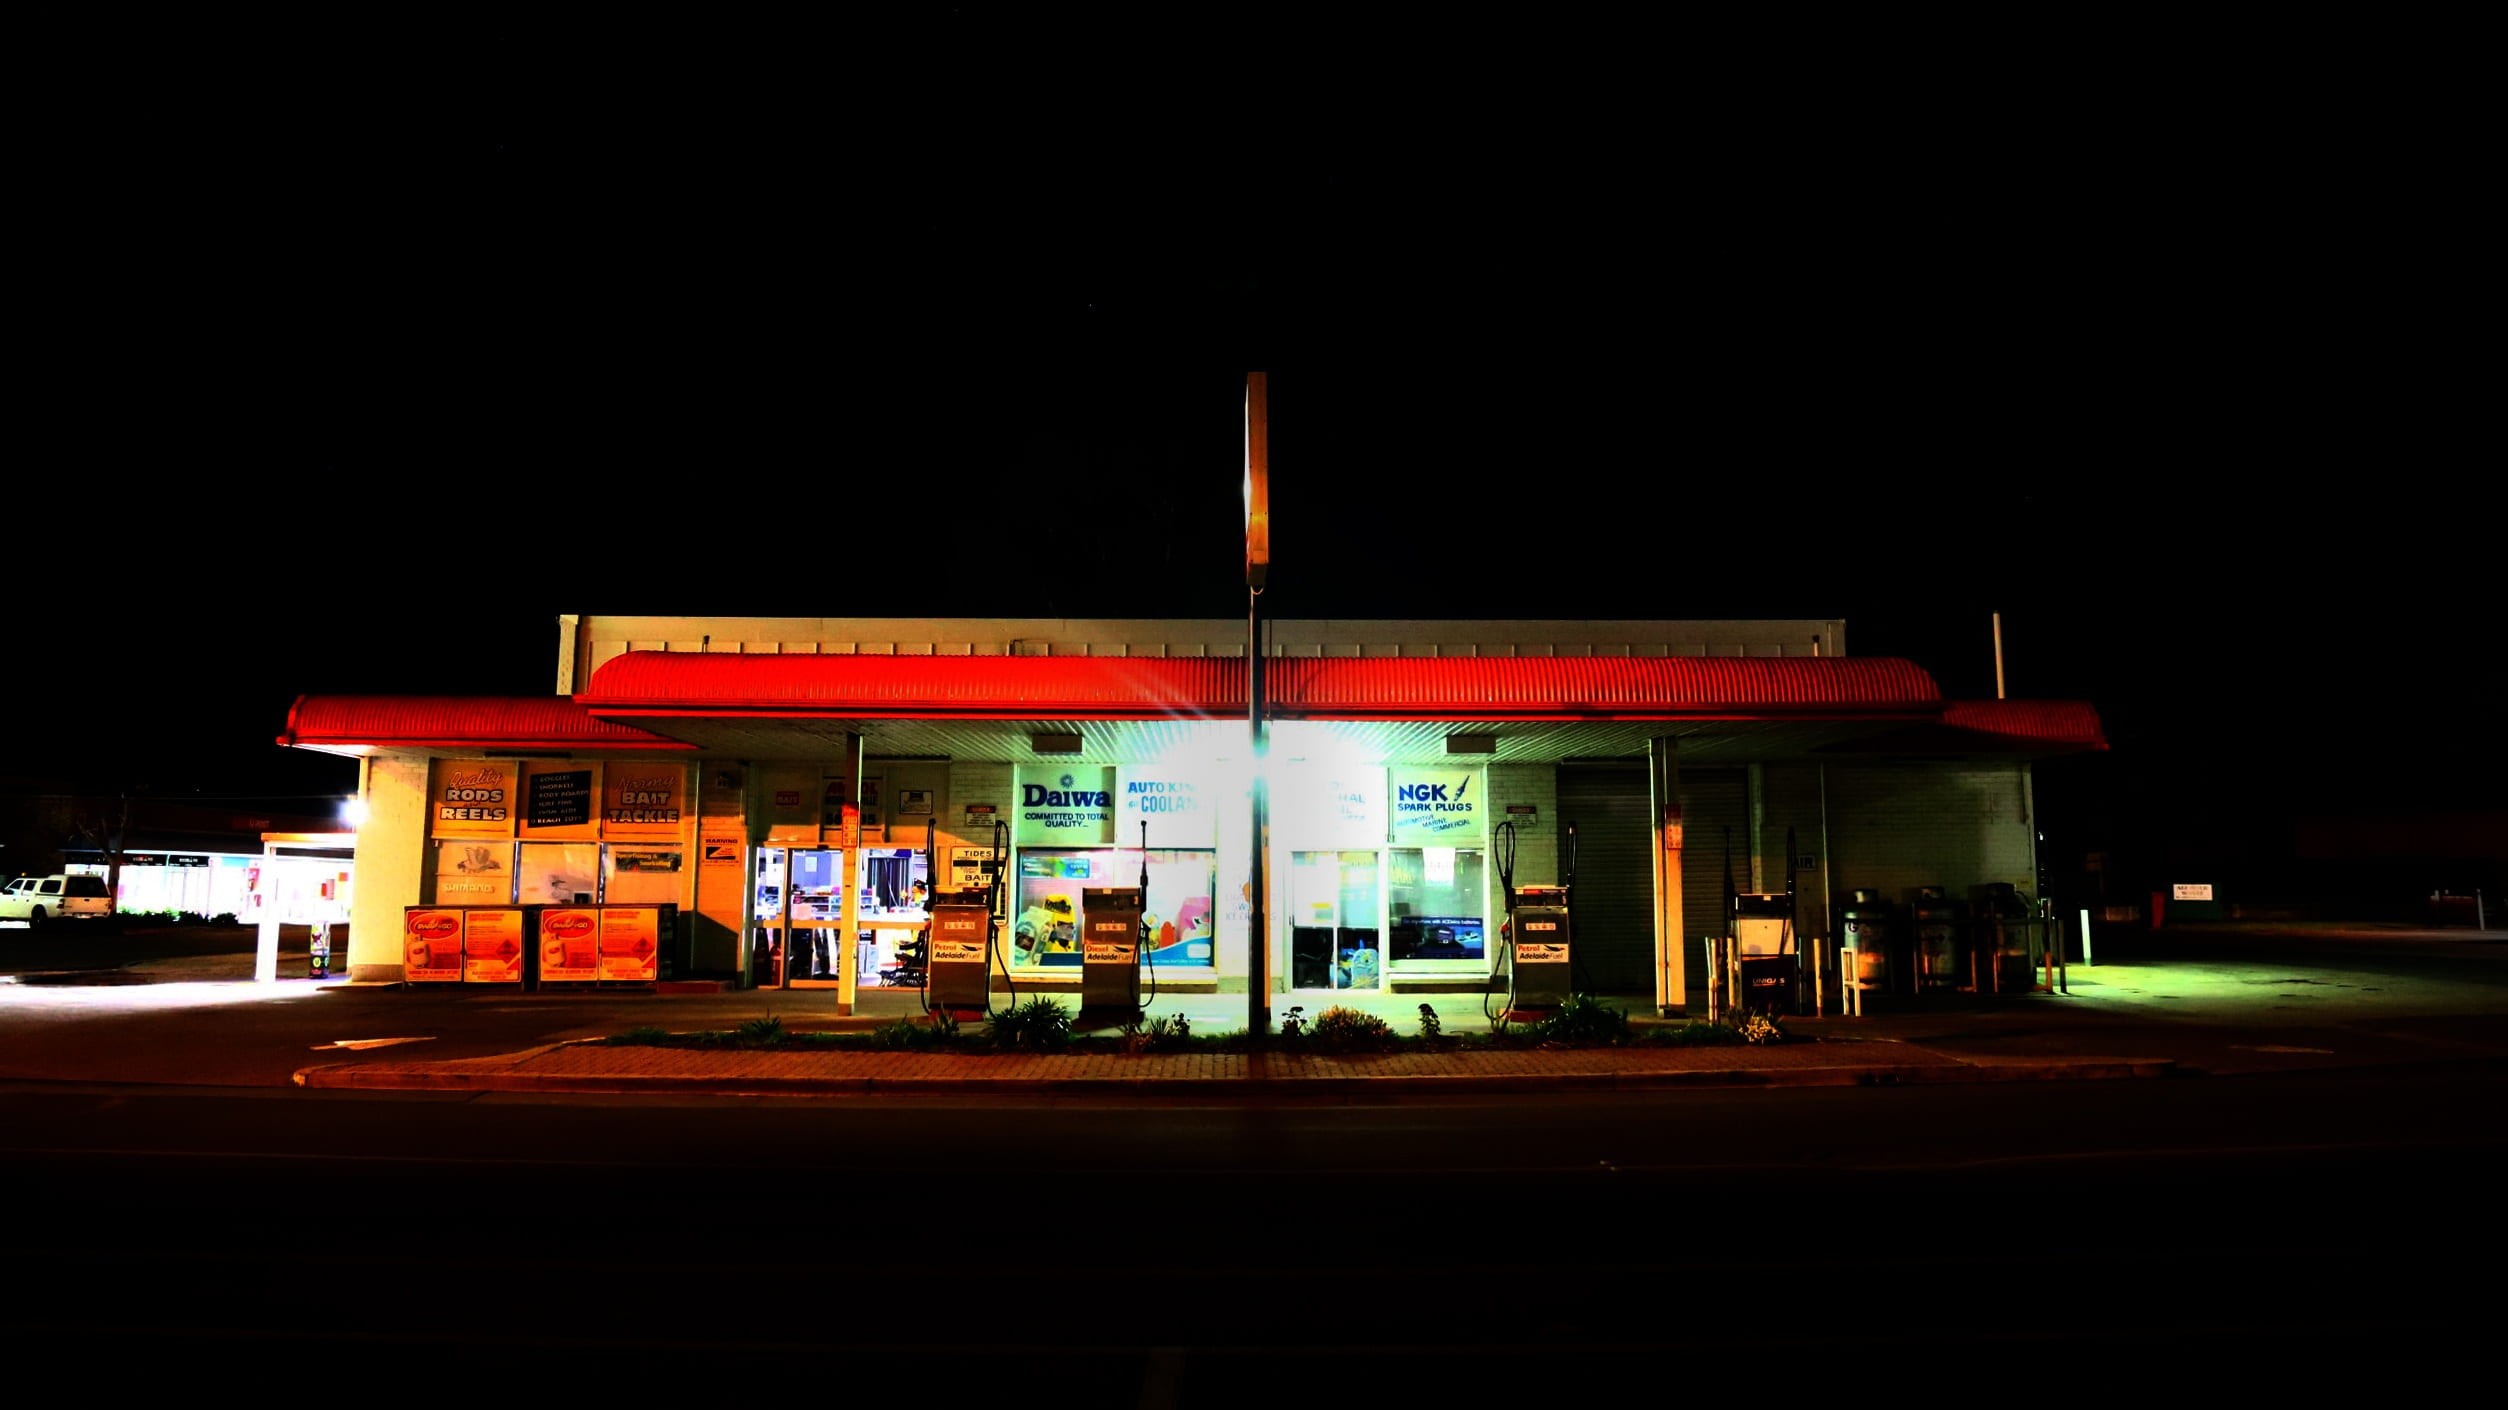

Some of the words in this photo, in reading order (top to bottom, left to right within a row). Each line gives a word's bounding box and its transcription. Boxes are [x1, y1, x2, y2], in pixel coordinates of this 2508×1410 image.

[449, 767, 503, 790] Quality
[1128, 782, 1165, 793] AUTO
[1398, 784, 1448, 802] NGK
[446, 788, 503, 802] RODS
[621, 791, 671, 805] BAIT
[1022, 784, 1112, 808] Daiwa
[440, 807, 507, 821] REELS
[1398, 803, 1432, 812] SPARK
[1435, 803, 1473, 812] PLUGS
[608, 808, 679, 823] TACKLE
[1025, 812, 1074, 821] COMMITTED
[1076, 813, 1086, 821] TO
[1087, 812, 1110, 821] TOTAL
[964, 874, 990, 882] BAIT
[934, 943, 957, 951] Petrol
[1086, 945, 1109, 953] Diesel
